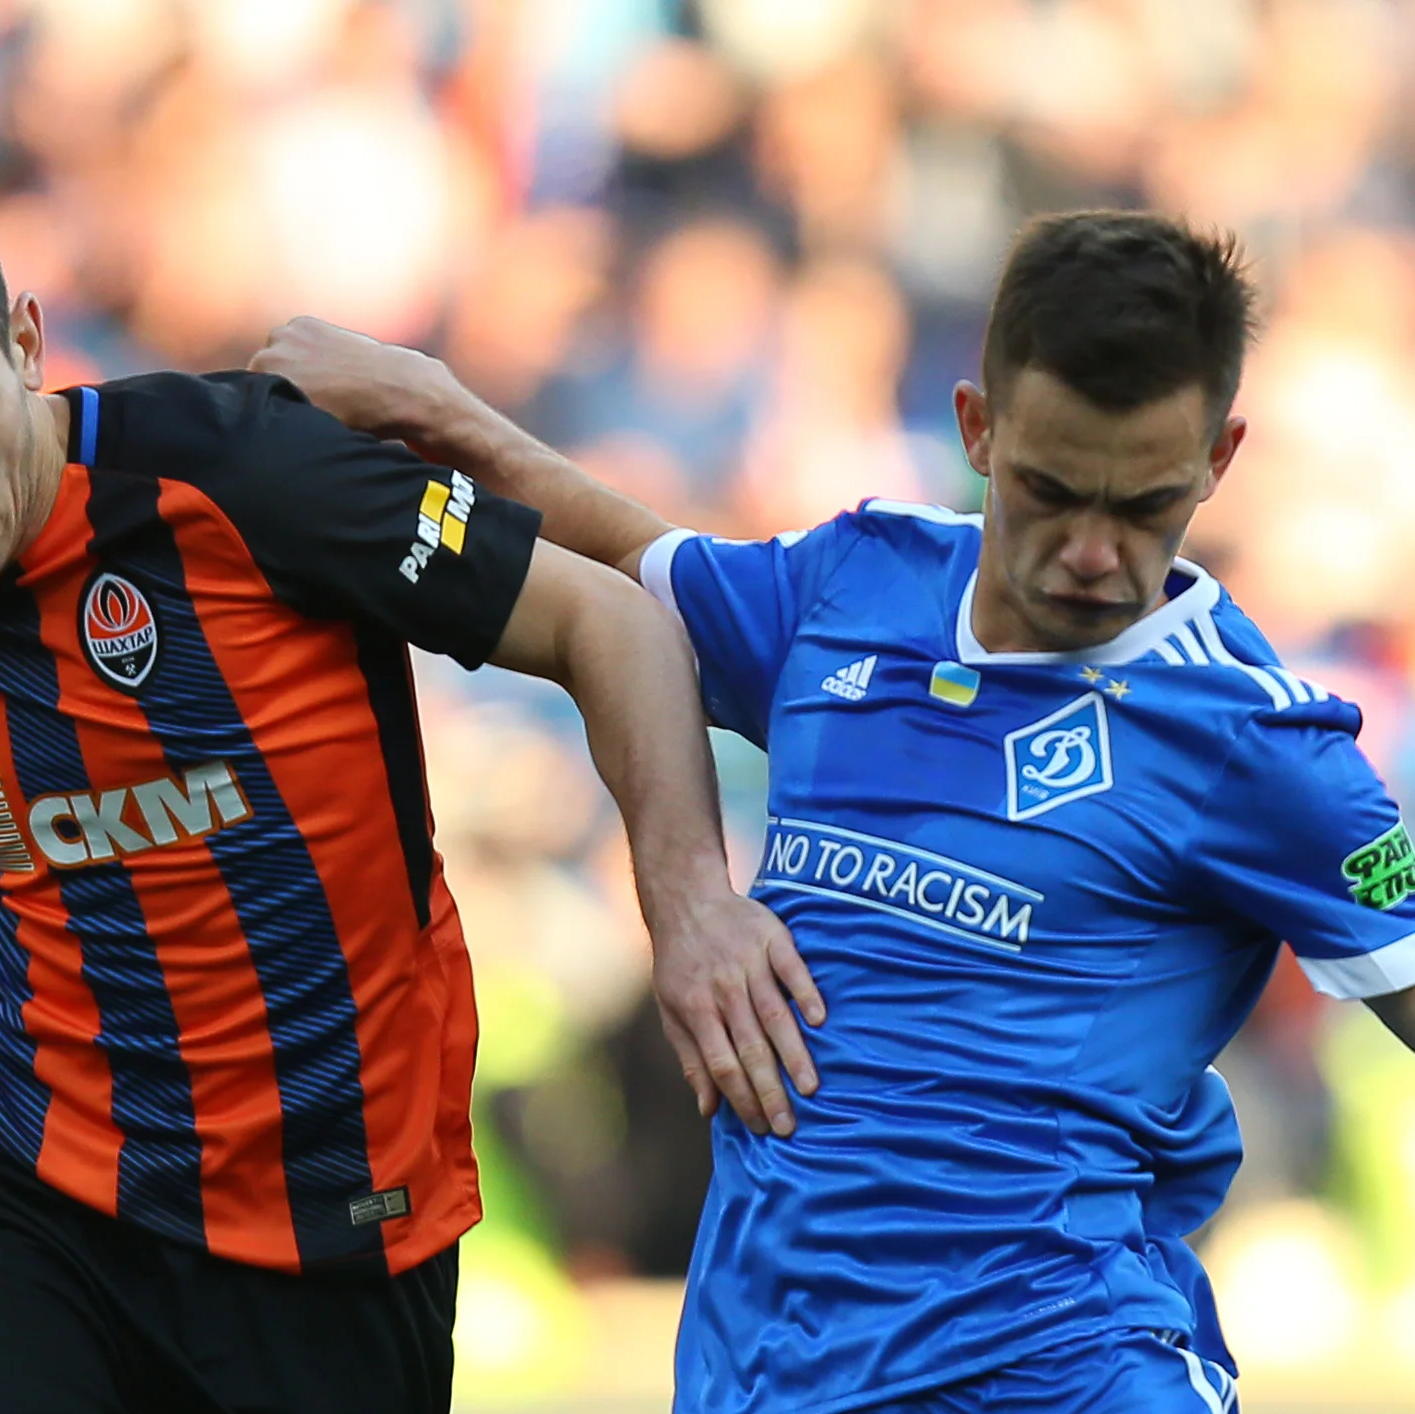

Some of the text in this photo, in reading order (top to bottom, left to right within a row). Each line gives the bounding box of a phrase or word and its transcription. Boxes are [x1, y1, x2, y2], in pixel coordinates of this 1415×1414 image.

[398, 511, 442, 584] PARI
[91, 625, 154, 656] ШАХТАР
[766, 832, 1033, 944] NO TO RACISM
